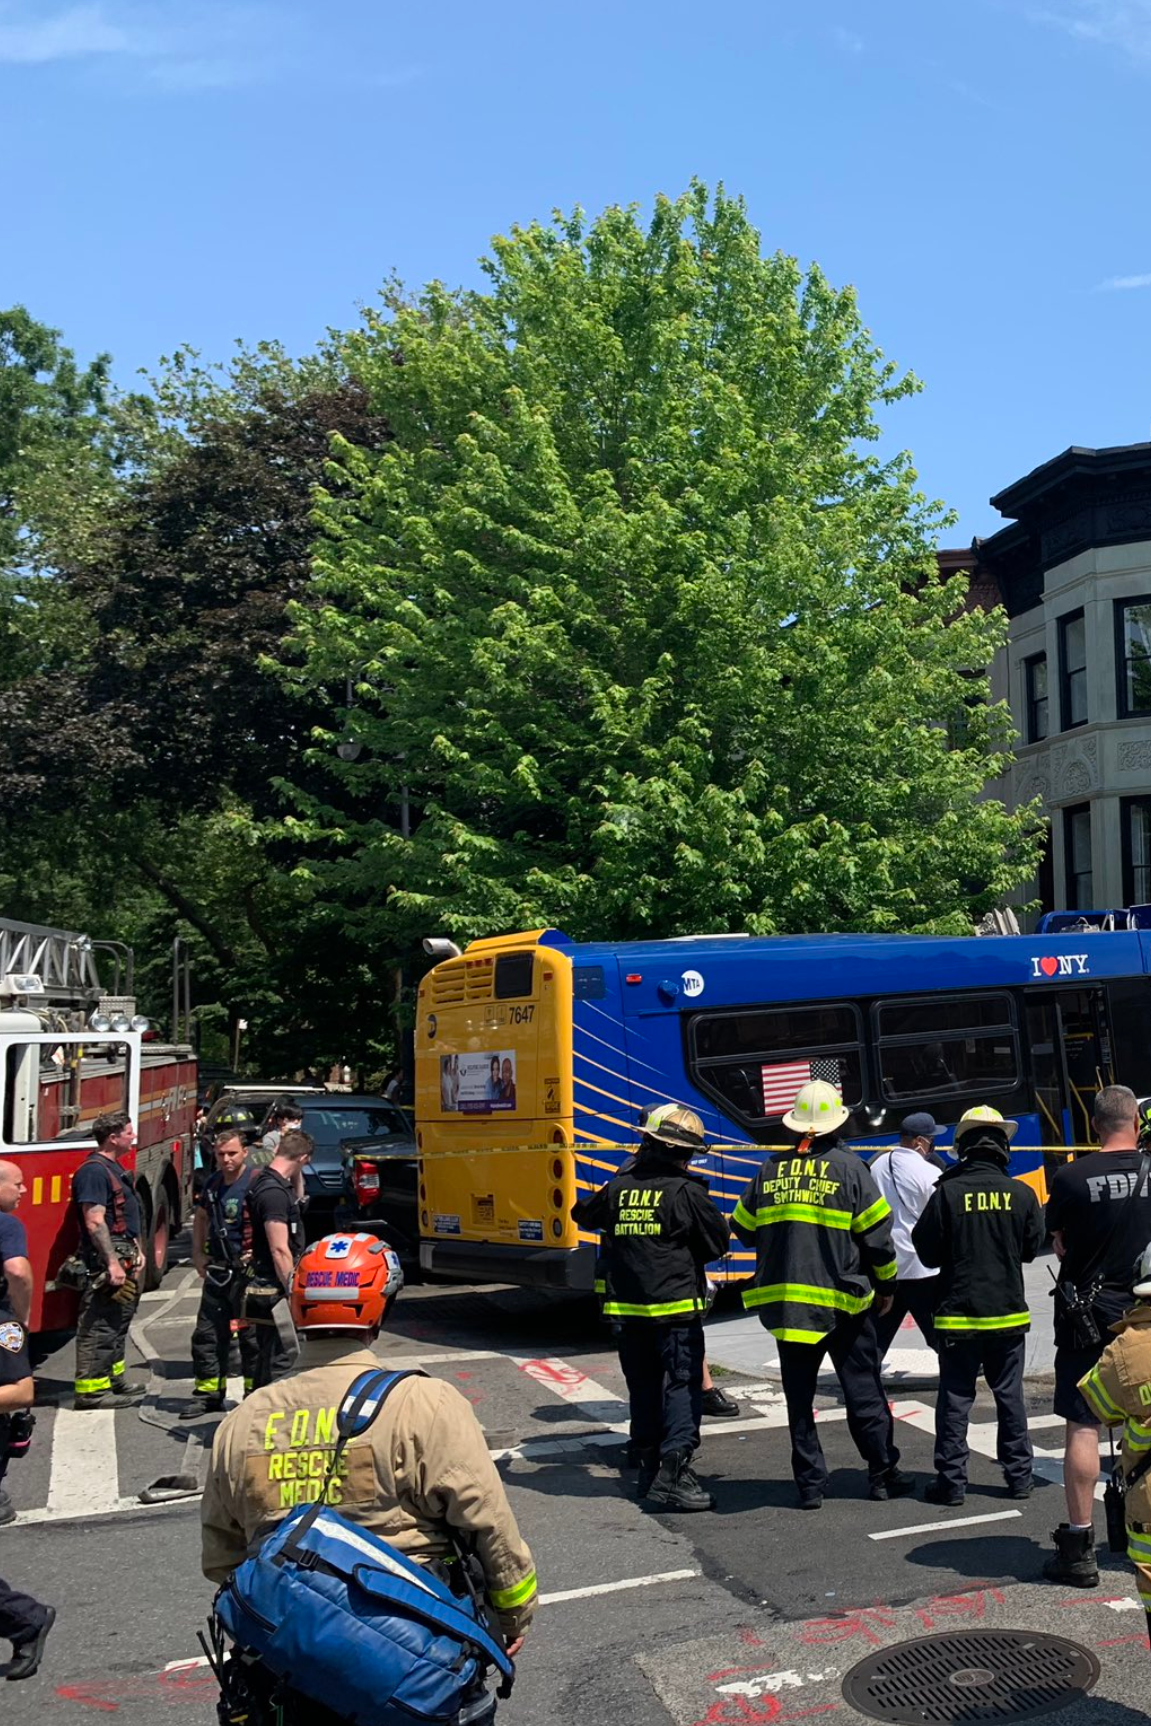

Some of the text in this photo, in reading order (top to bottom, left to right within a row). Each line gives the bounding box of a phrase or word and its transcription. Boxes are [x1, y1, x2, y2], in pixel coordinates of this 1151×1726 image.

[684, 977, 700, 991] MTA
[509, 1005, 535, 1024] 7647
[778, 1159, 830, 1178] F.D.N.Y.
[763, 1177, 840, 1195] DEPUTY CHIEF
[619, 1190, 663, 1207] F.D.N.Y.
[964, 1192, 1012, 1212] F.D.N.Y.
[619, 1209, 655, 1221] RESCUE
[615, 1223, 661, 1236] BATTALION
[307, 1271, 360, 1287] RESCUE MEDIC
[268, 1449, 350, 1480] RESCUE
